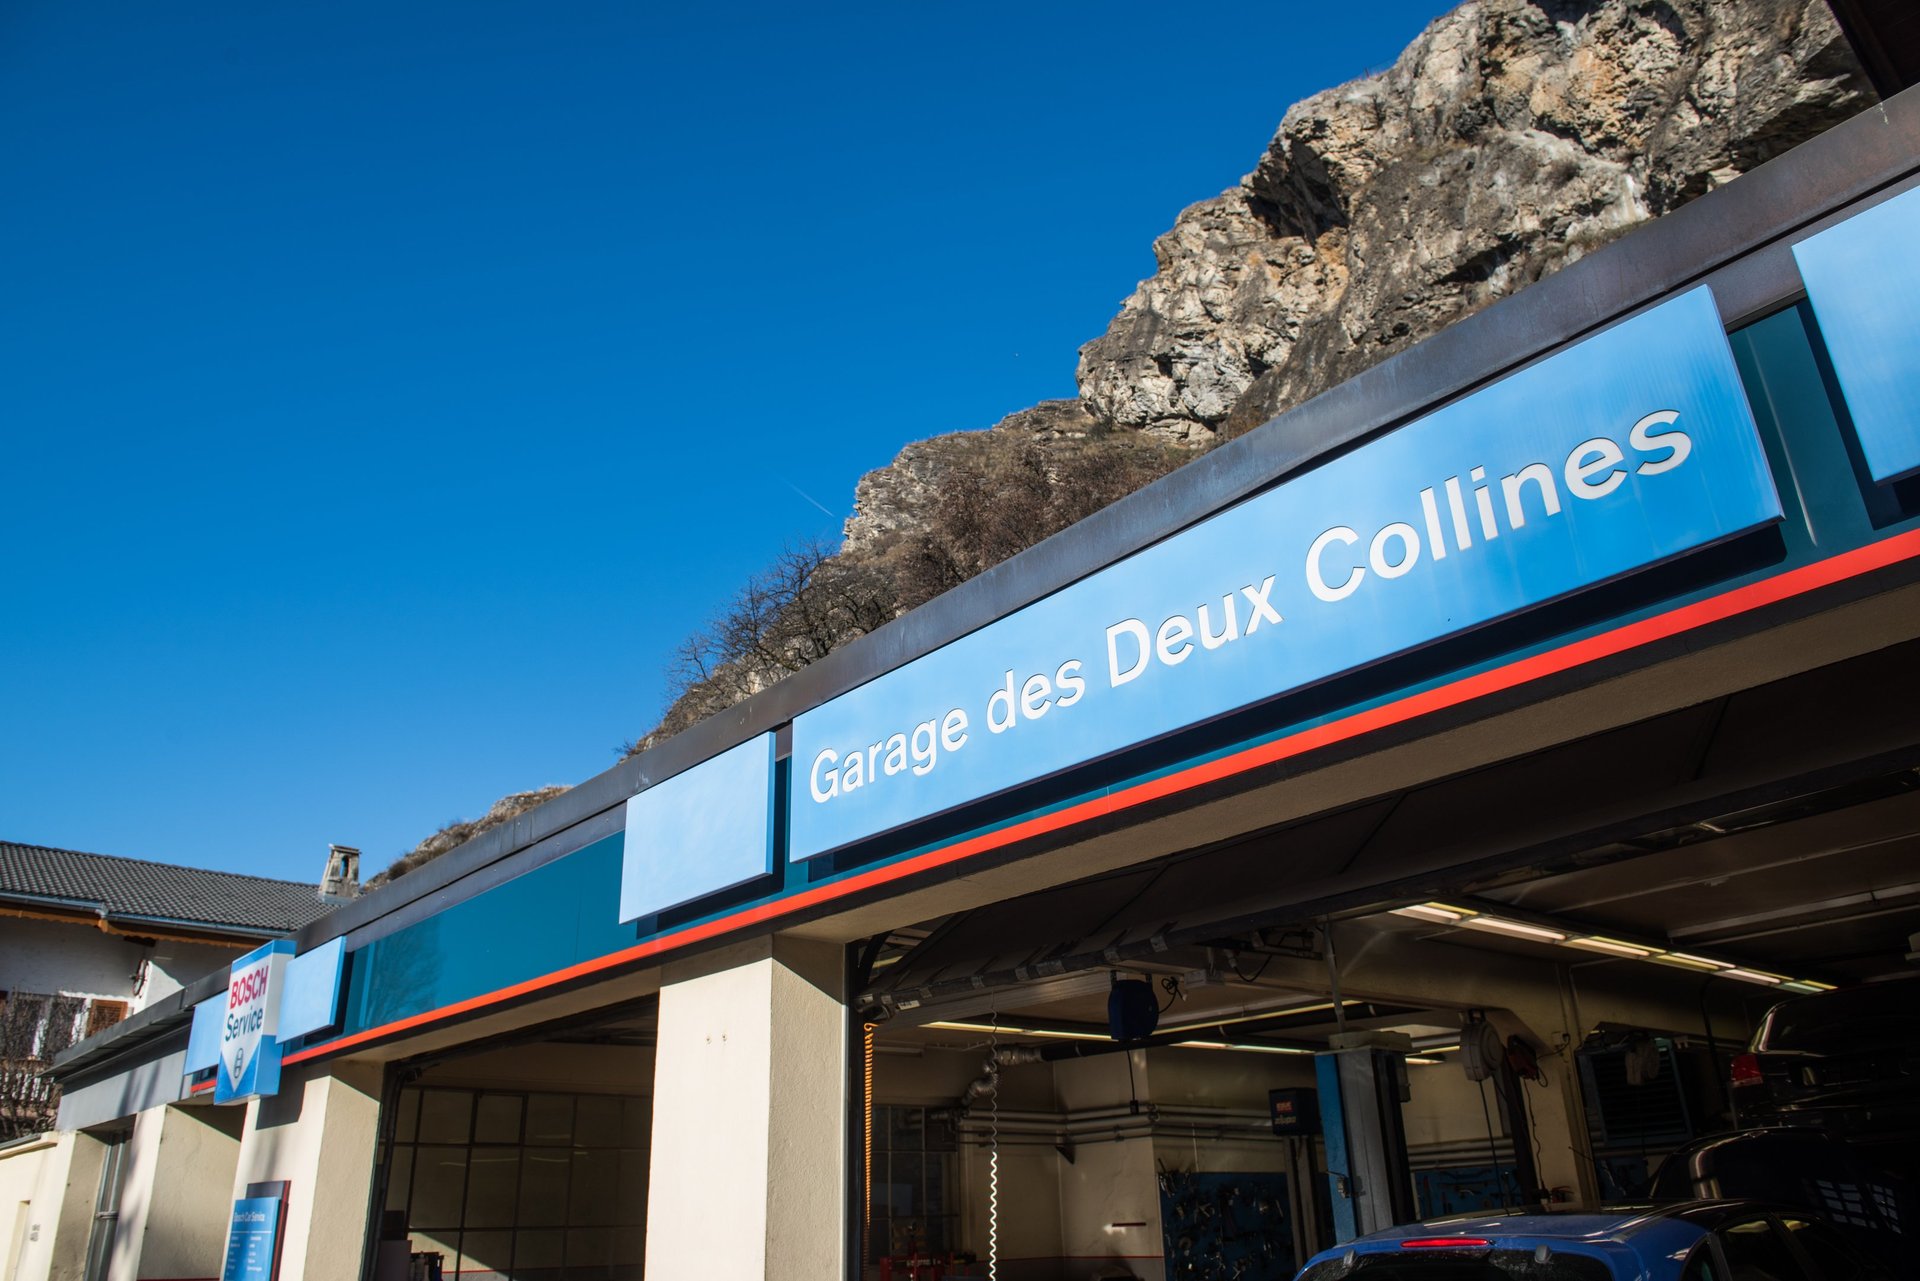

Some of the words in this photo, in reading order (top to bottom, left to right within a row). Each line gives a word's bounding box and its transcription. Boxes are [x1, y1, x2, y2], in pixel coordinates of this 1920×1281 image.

[808, 708, 969, 803] Garage
[986, 658, 1086, 735] des
[1105, 574, 1285, 688] Deux
[1305, 408, 1692, 602] Collines
[230, 966, 270, 1009] BOSCH
[225, 1006, 264, 1042] Service
